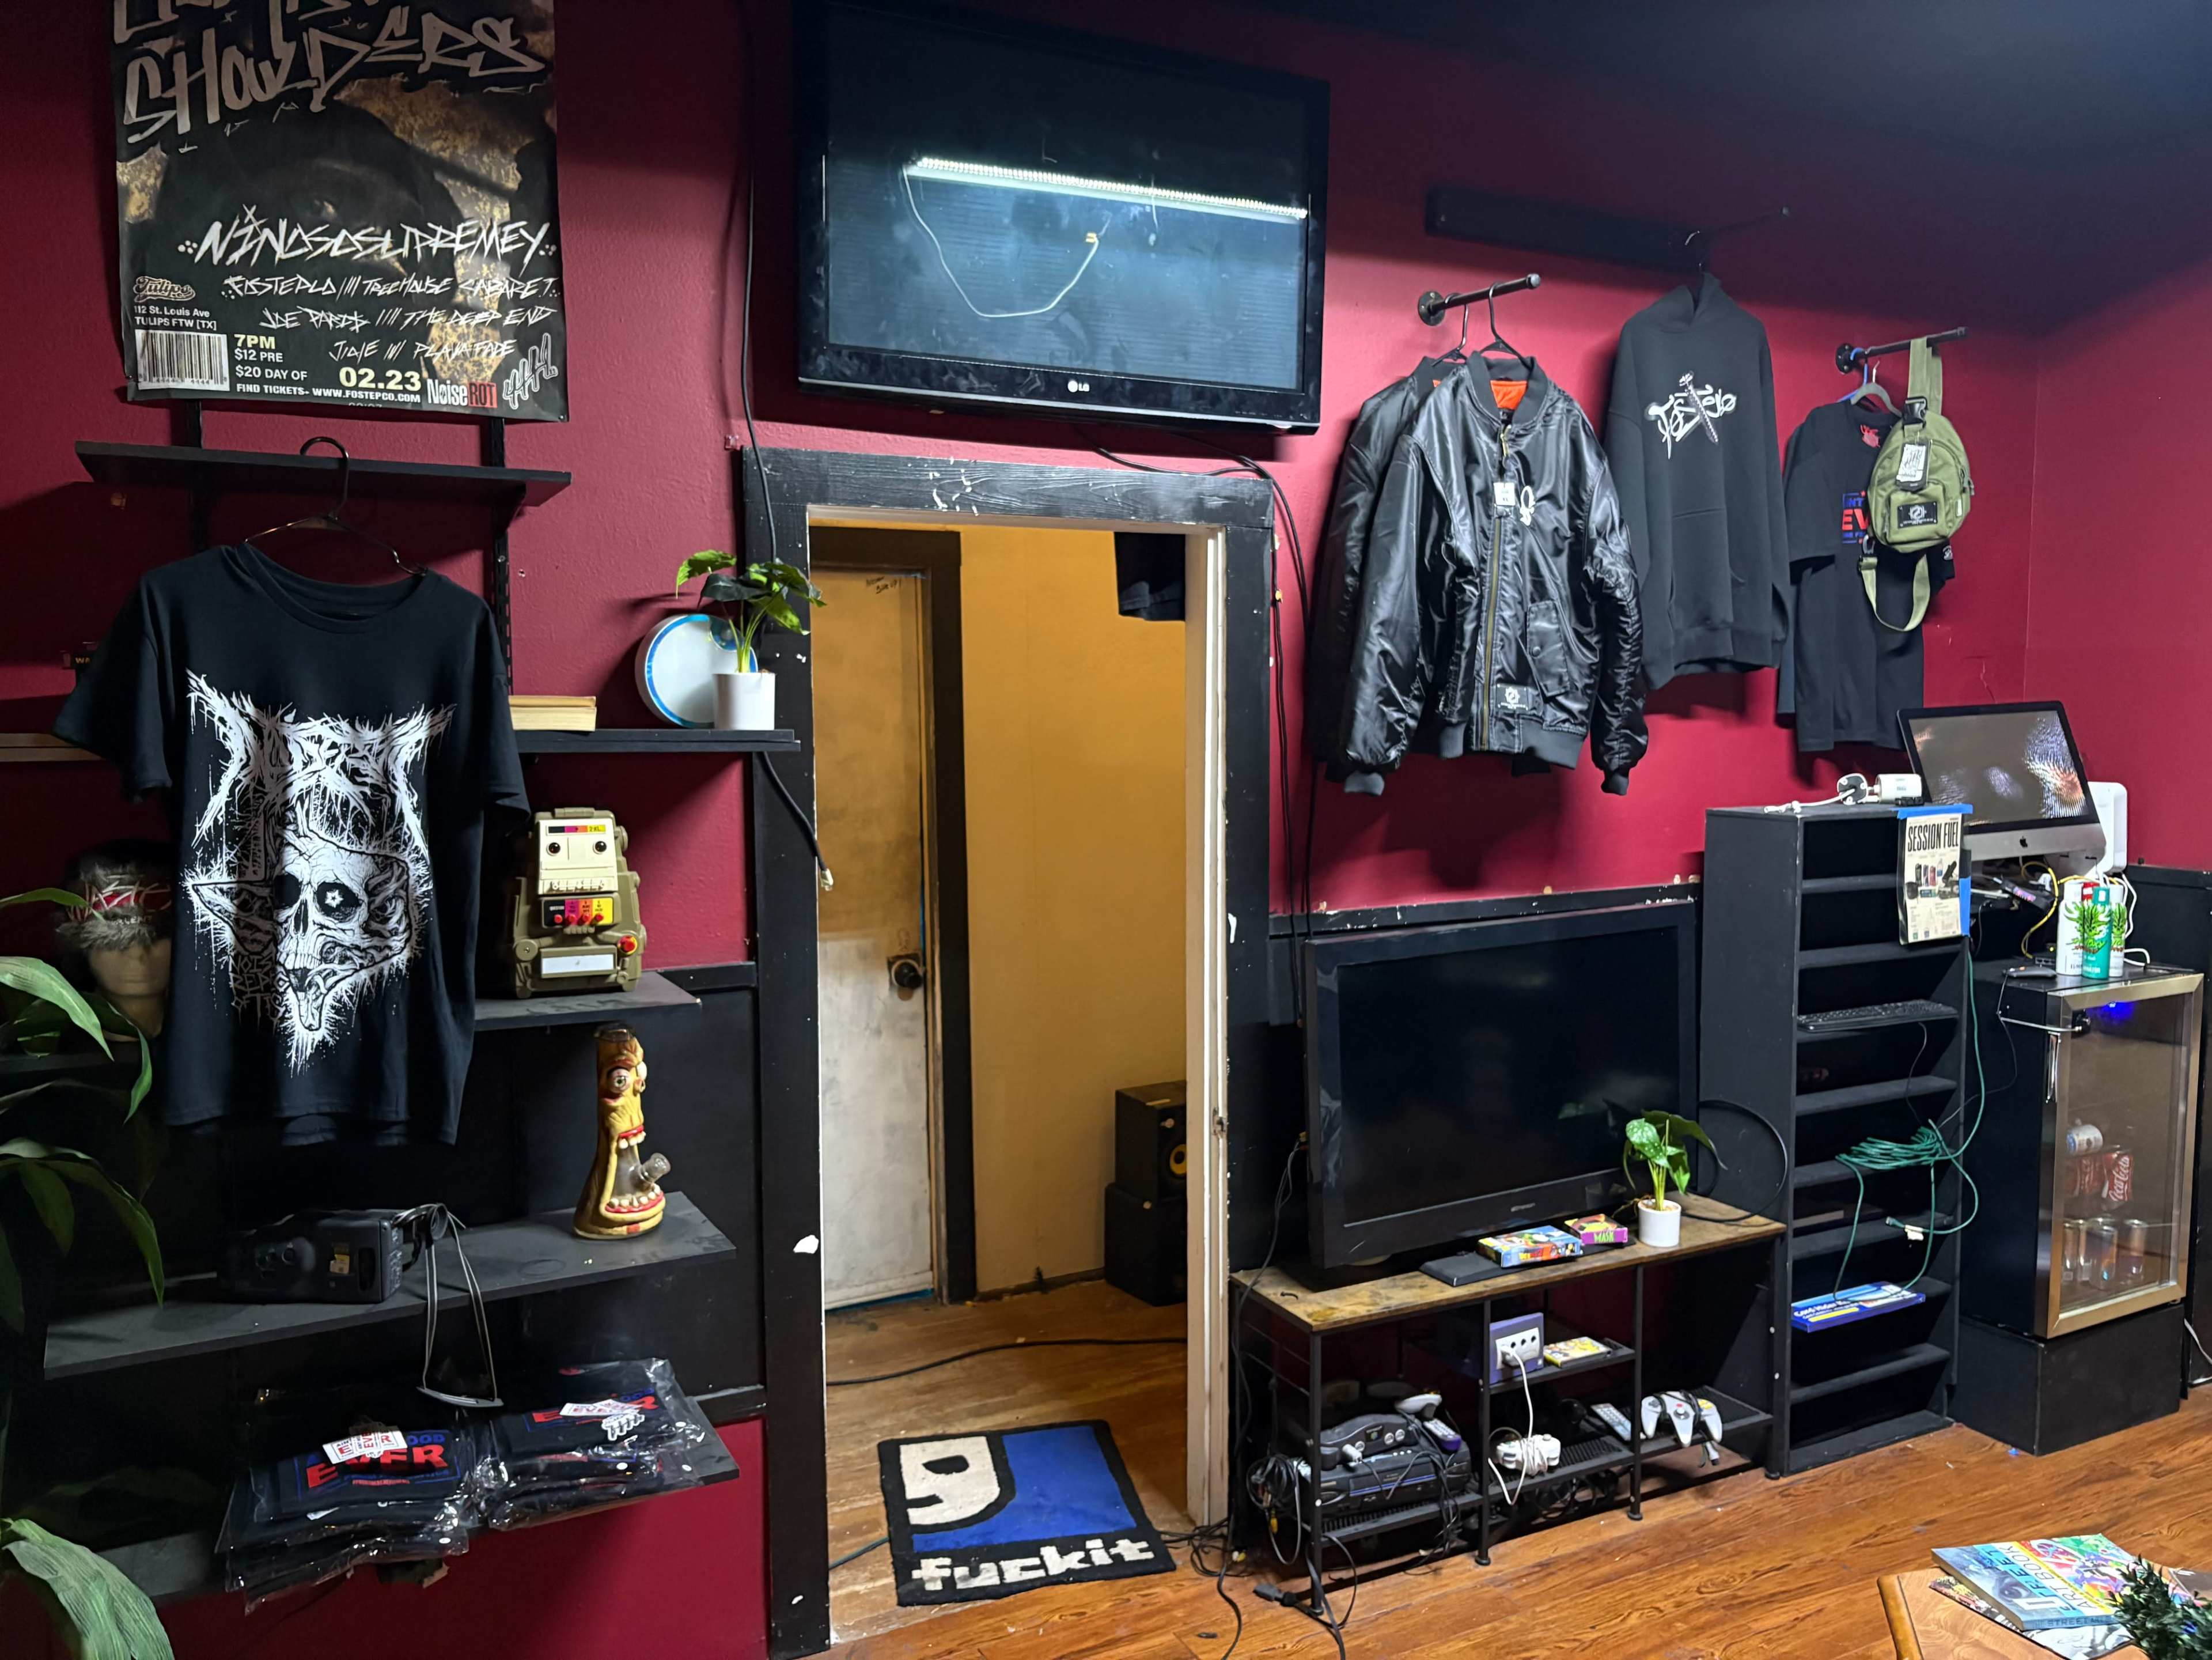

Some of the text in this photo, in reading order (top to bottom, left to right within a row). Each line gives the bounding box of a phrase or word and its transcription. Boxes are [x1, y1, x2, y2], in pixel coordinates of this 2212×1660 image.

[134, 276, 196, 303] Tulips
[134, 305, 210, 317] 112 St. Louis Ave
[400, 307, 447, 330] THE
[449, 309, 502, 327] DEEP
[503, 306, 558, 327] END
[135, 316, 217, 331] TULIPS FTW [TX]
[234, 334, 276, 349] 7PM
[234, 347, 283, 363] $12 PRE
[235, 364, 308, 381] $20 DAY OF
[339, 366, 422, 392] 02.23
[236, 383, 260, 393] FIND
[312, 388, 421, 403] WWW.FOSTEPCO.COM
[1907, 821, 1959, 852] SESSION FUEL
[911, 1538, 1154, 1591] fuckit
